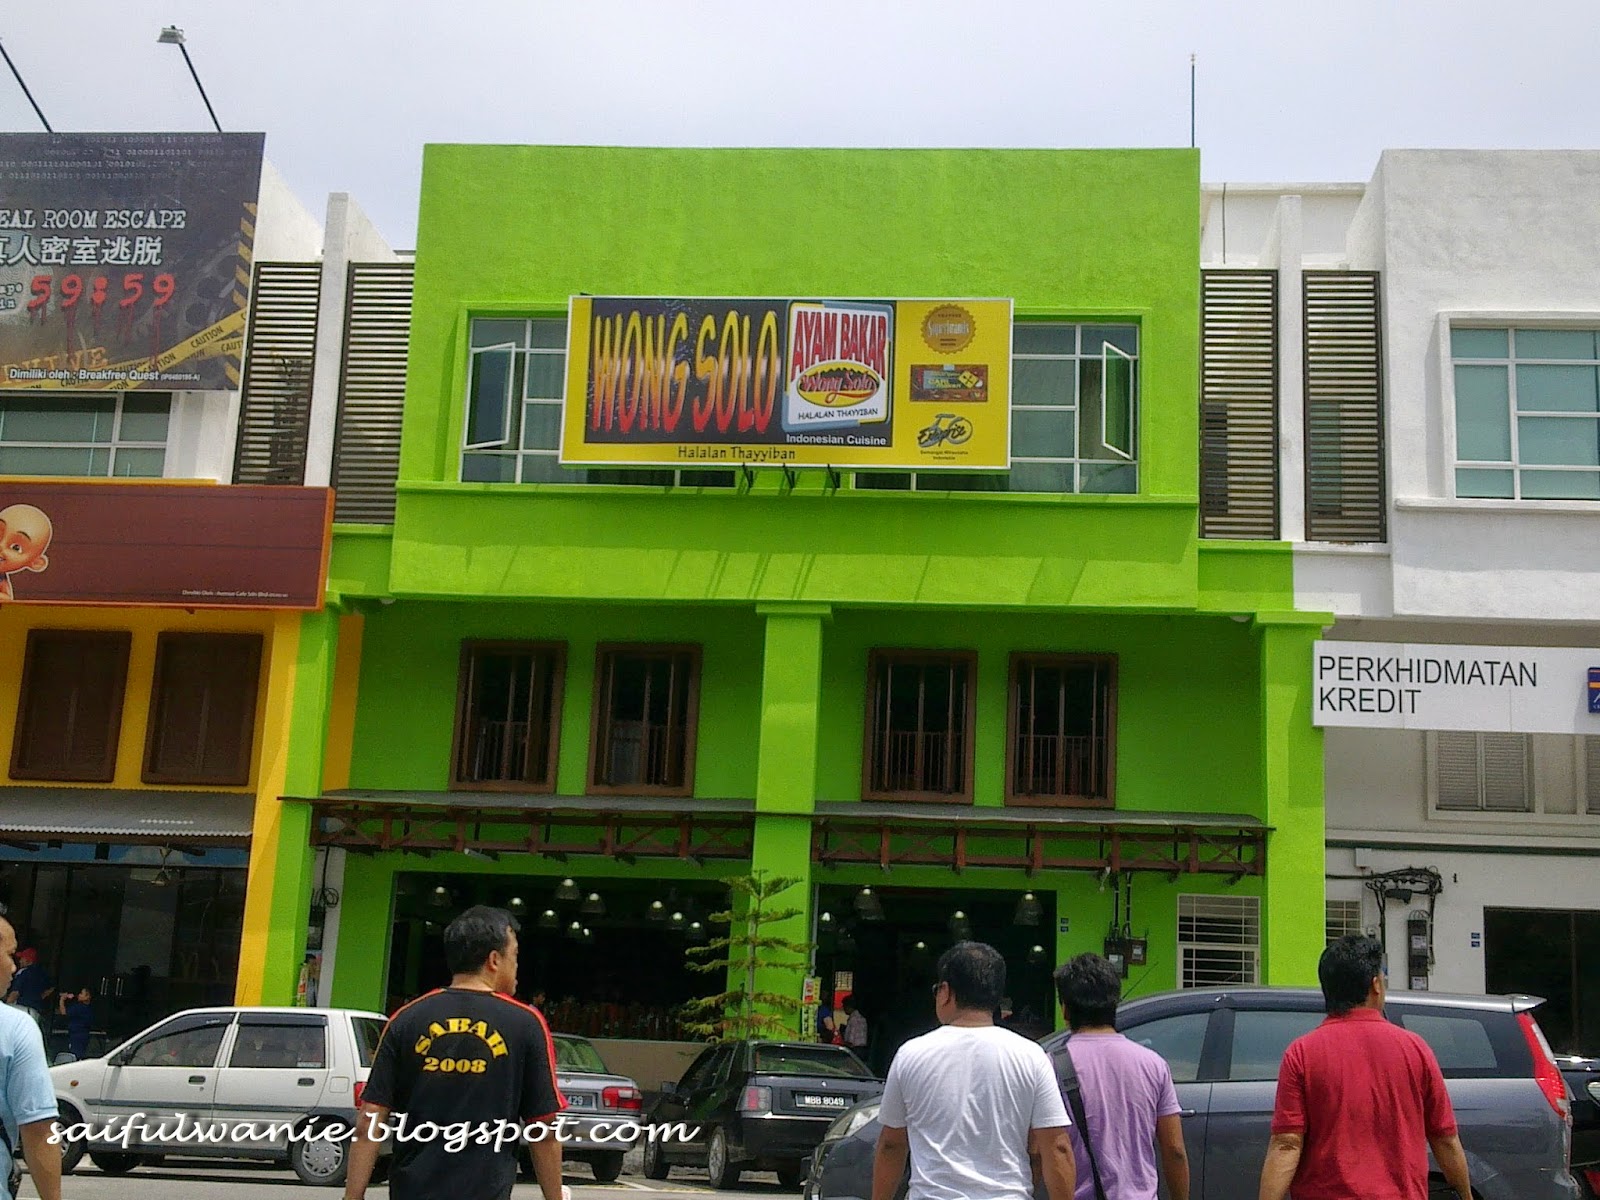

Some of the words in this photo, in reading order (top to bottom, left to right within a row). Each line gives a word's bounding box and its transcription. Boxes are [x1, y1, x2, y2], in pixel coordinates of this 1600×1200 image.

[42, 209, 98, 229] ROOM
[103, 209, 187, 229] ESCAPE
[190, 325, 224, 348] CAUTION
[791, 311, 838, 382] AYAM
[841, 313, 887, 381] BAKAR
[9, 368, 47, 379] Dimiliki
[49, 369, 70, 379] oleh
[79, 369, 126, 380] Breakfree
[129, 370, 159, 380] Quest
[592, 310, 690, 434] WONG
[692, 310, 781, 434] SOLO
[798, 411, 835, 420] HALALAN
[837, 408, 879, 417] THAYYIBAN
[786, 433, 844, 445] Indonesian
[846, 435, 887, 446] Cuisine
[678, 446, 727, 458] Halalan
[730, 446, 795, 462] Thayyiban
[1318, 655, 1538, 687] PERKHIDMATAN
[1318, 686, 1422, 714] KREDIT
[414, 1017, 509, 1059] SABAH
[422, 1057, 487, 1073] 2008
